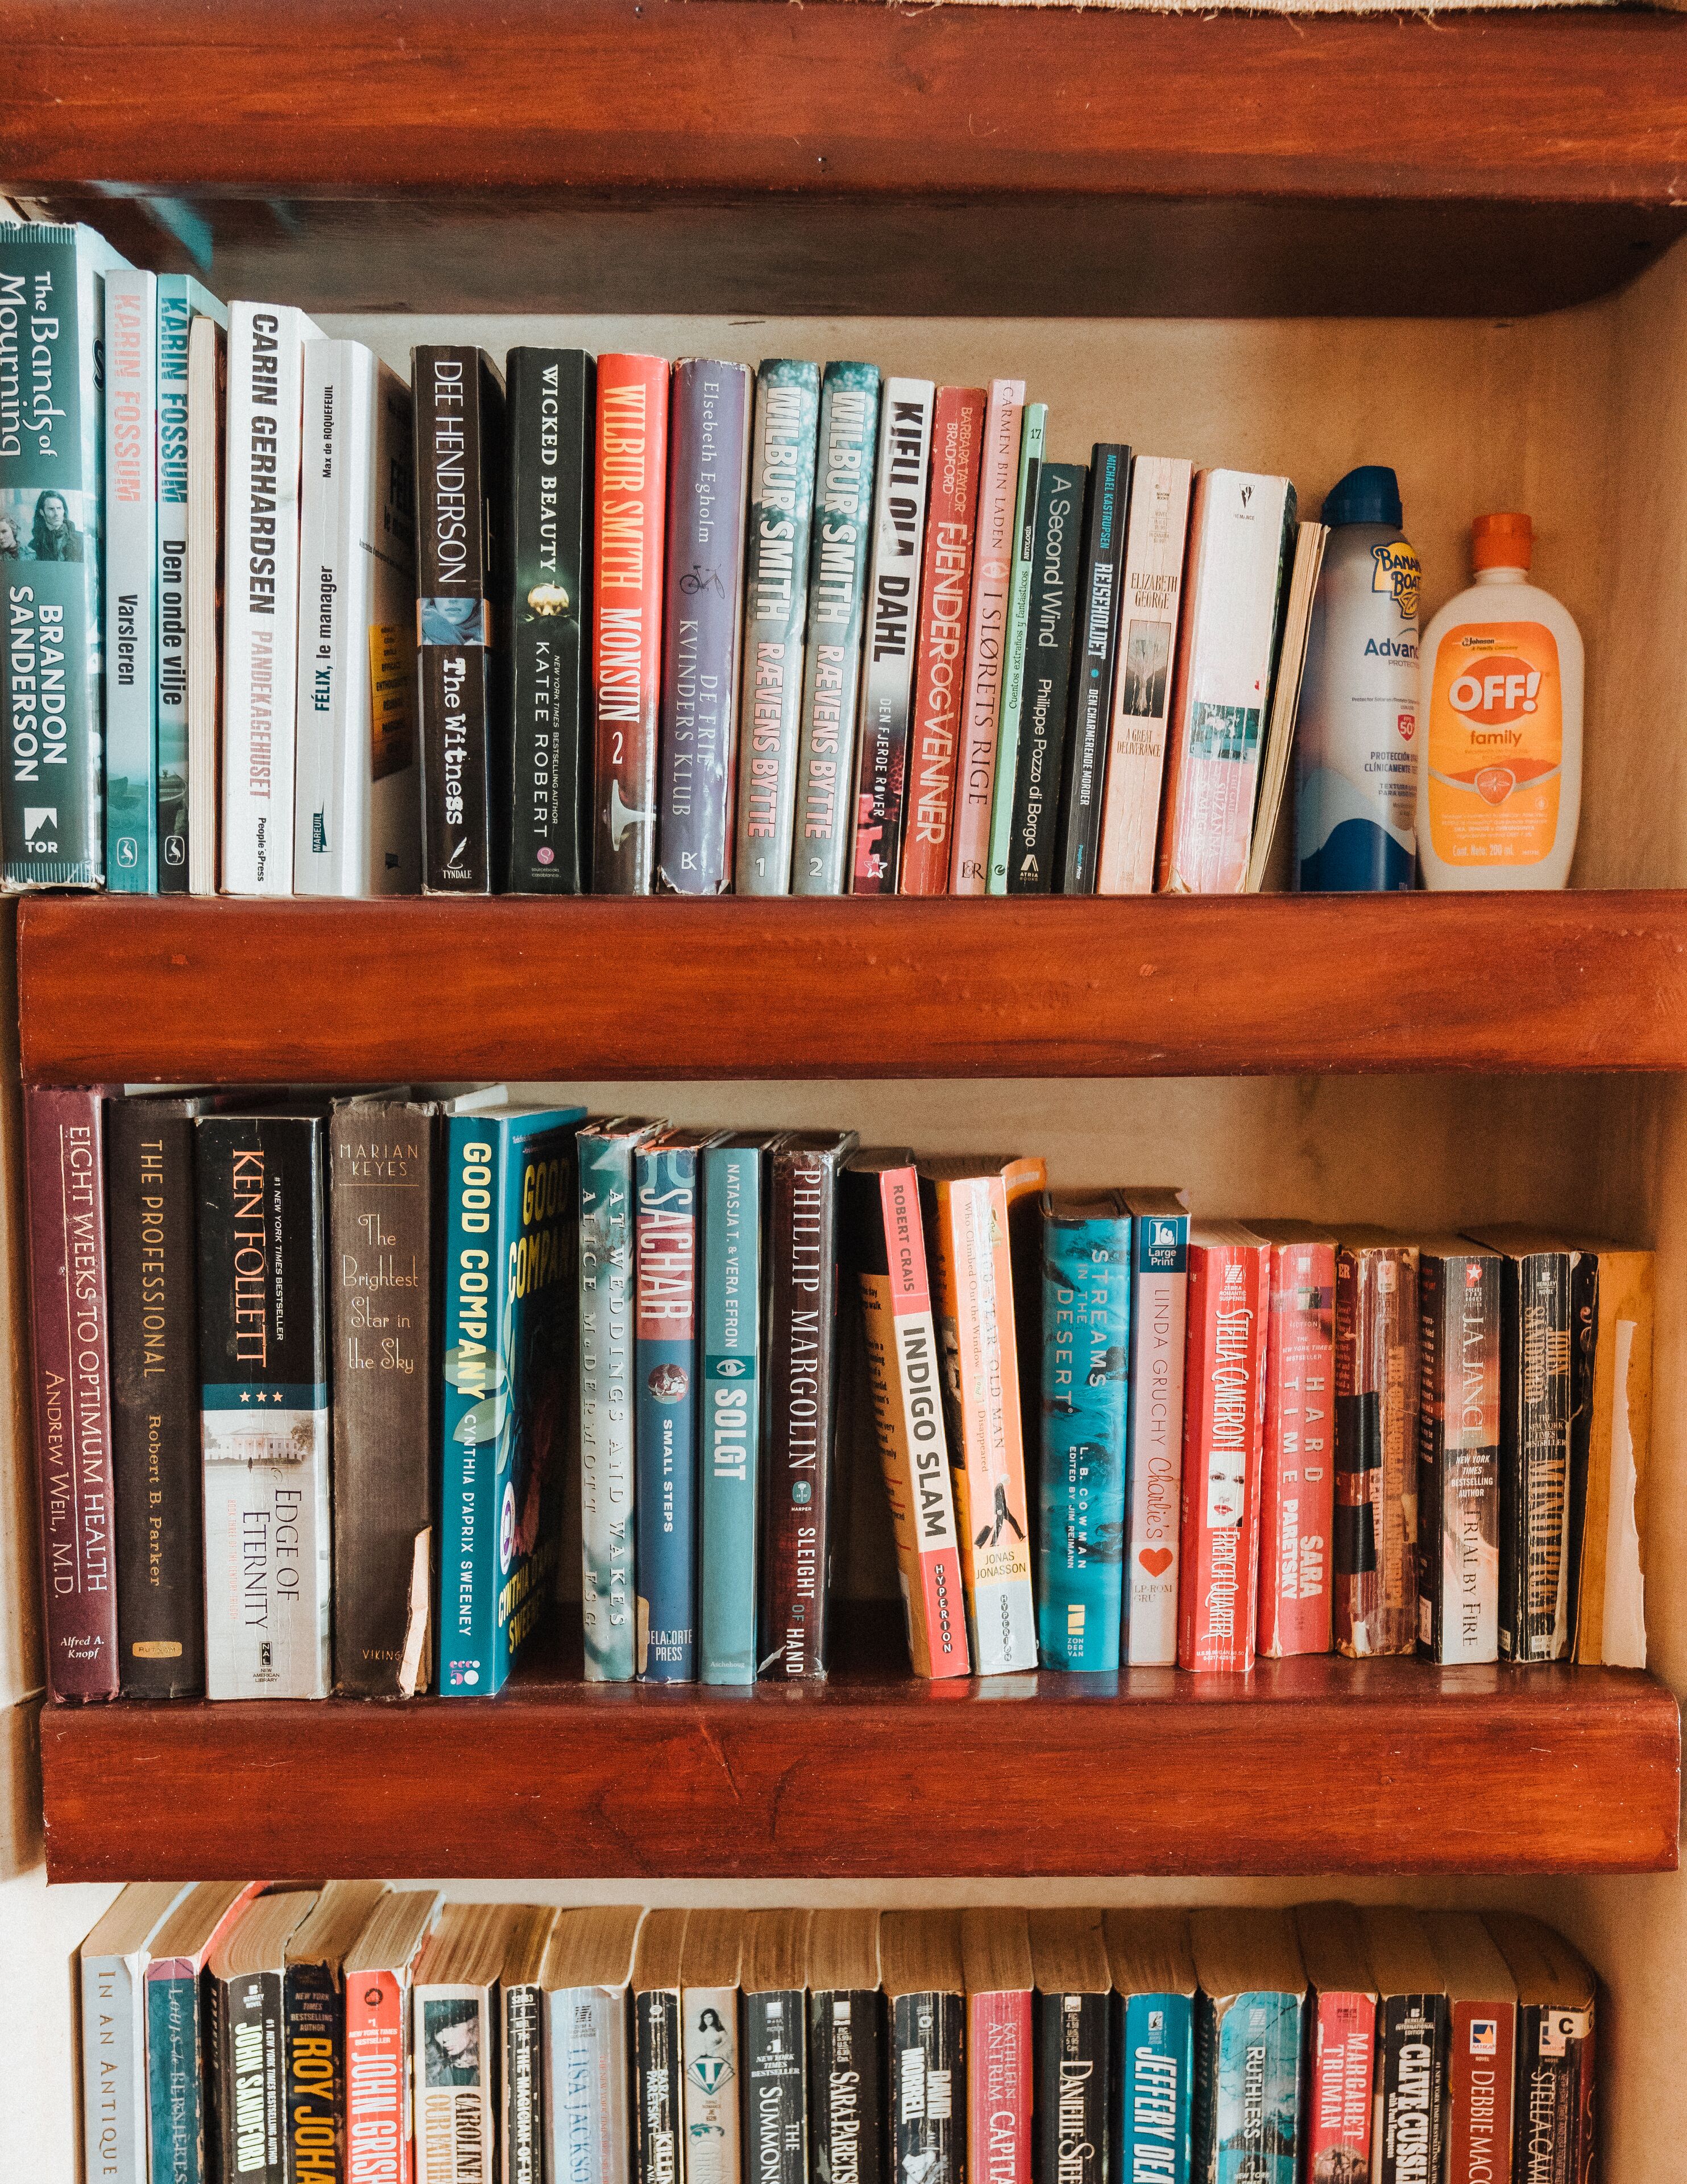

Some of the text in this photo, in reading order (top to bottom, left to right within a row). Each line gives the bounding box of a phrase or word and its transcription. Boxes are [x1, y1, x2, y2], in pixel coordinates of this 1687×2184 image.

[34, 271, 53, 311] The
[161, 297, 189, 503] KARIN FOSSUM
[1030, 428, 1042, 439] 17
[250, 313, 279, 614] CARIN GERHARDSEN
[323, 444, 332, 478] Max de
[434, 362, 466, 582] DEE HENDERSON
[540, 365, 558, 572] WICKED BEAUTY
[996, 462, 1008, 494] BIN
[599, 383, 646, 723] WILBUR SMITH MONSUN
[1038, 475, 1072, 647] A Second Wind
[118, 594, 138, 686] Varsleren
[160, 540, 187, 705] Den onde vilje
[316, 646, 331, 659] le
[748, 387, 802, 838] WILBUR SMITH BYTTE
[805, 391, 866, 839] WILBUR SMITH BYTTE
[873, 575, 910, 662] DAHL
[10, 586, 38, 781] SANDERSON
[39, 605, 67, 764] BRANDON
[673, 620, 698, 816] KVINDERS KLUB
[878, 698, 892, 723] DEN
[1088, 689, 1099, 705] DEN
[1449, 672, 1541, 712] OFF!
[443, 657, 467, 824] The Witness
[534, 642, 550, 837] KATEE ROBERT
[612, 731, 623, 764] 2
[1022, 679, 1052, 846] Philippe Pozzo di Borgo
[1471, 730, 1522, 747] family
[25, 841, 58, 854] TOR
[442, 870, 472, 879] TYNDALE
[756, 858, 765, 877] 1
[809, 857, 823, 877] 2
[340, 1144, 418, 1159] MARIAN
[352, 1161, 408, 1176] KEYES
[141, 1139, 165, 1378] THE PROFESSIONAL
[232, 1149, 267, 1368] KEN FOLLETT
[273, 1177, 283, 1275] #1 NEW YORK TIMES
[457, 1142, 492, 1400] GOOD COMPANY
[640, 1188, 693, 1318] SACHAR
[727, 1232, 739, 1242] T.
[893, 1185, 914, 1292] ROBERT CRAIS
[964, 1201, 979, 1322] Who Out the
[1148, 1248, 1177, 1259] Large
[1150, 1258, 1174, 1267] Print
[397, 1314, 411, 1327] in
[726, 1257, 739, 1294] VERA
[789, 1168, 820, 1470] PHILLIP MARGOLIN
[1076, 1264, 1087, 1324] IN THE
[1089, 1249, 1108, 1388] STREAMS
[70, 1126, 107, 1591] EIGHT WEEKS TO OPTIMUM HEALTH
[725, 1300, 739, 1347] EFRON
[1150, 1290, 1170, 1446] LINDA GRUCHY
[664, 1419, 673, 1533] SMALL STEPS
[714, 1389, 747, 1480] SOLGT
[903, 1327, 947, 1537] INDIGO SLAM
[1079, 1446, 1088, 1480] L. B.
[148, 1414, 163, 1586] Robert B. Parker
[227, 1500, 238, 1591] BOOK CENTURY
[458, 1414, 476, 1636] CYNTHIA SWEENEY
[1067, 1446, 1076, 1569] EDITED BY JIM REIMANN
[242, 1511, 271, 1629] ETERNITY
[1282, 1499, 1298, 1599] PARETSKY
[1299, 1536, 1323, 1599] SARA
[1462, 1573, 1476, 1595] BY
[61, 1635, 105, 1646] Alfred A.
[786, 1528, 816, 1673] SLEIGHT OF HAND
[68, 1649, 100, 1660] Knopf
[656, 1647, 683, 1661] PRESS
[292, 2037, 334, 2101] ROY
[1558, 2018, 1574, 2034] C
[234, 2022, 266, 2173] JOHN SANDFORD
[266, 2019, 278, 2165] #1 NEW YORK TIMES AUTHOR
[351, 2052, 397, 2115] JOHN
[517, 2048, 530, 2165] THE OF
[657, 2069, 669, 2102] SARA
[828, 2071, 860, 2119] SARA
[1133, 2047, 1178, 2141] JEFFERY
[1243, 2046, 1266, 2139] RUTHLESS
[1320, 2044, 1344, 2128] TRUMAN
[1342, 2033, 1369, 2140] MARGARET
[1388, 2092, 1398, 2123] with Paul
[1397, 2044, 1431, 2109] CLIVE
[1469, 2070, 1495, 2133] DEBBIE
[785, 2121, 800, 2152] THE
